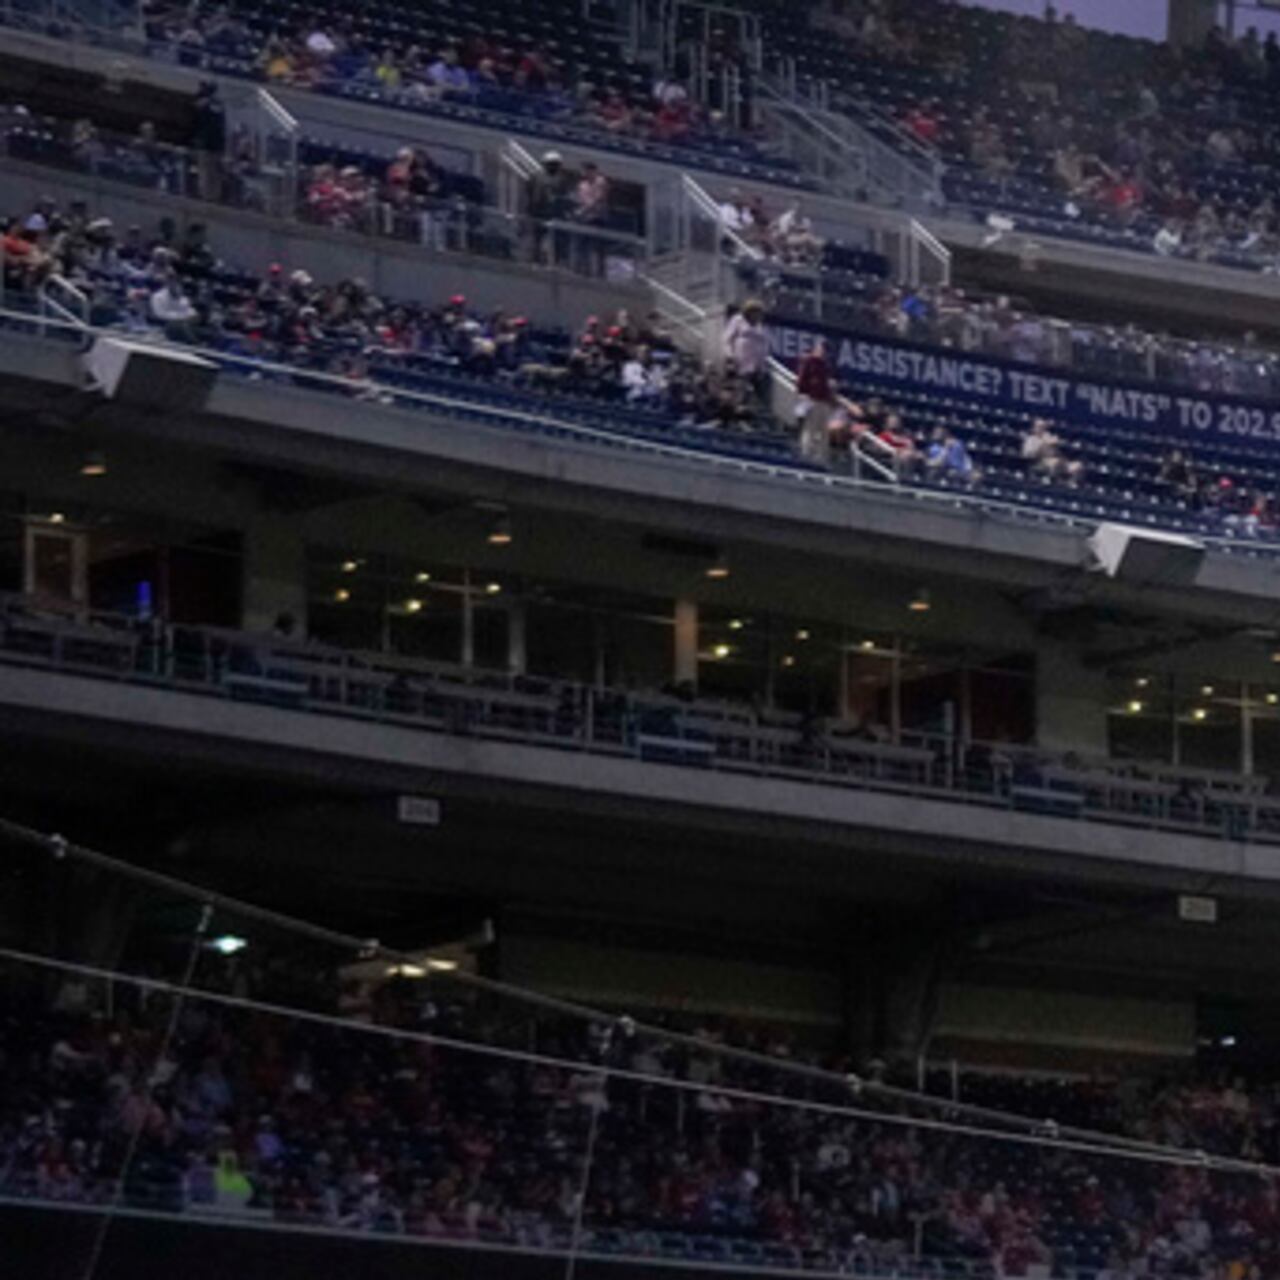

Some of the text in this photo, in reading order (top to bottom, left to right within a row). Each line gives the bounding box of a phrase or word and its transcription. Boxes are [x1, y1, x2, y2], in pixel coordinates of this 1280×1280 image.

[837, 338, 1002, 396] ASSISTANCE?
[1008, 370, 1070, 409] TEXT
[1176, 398, 1213, 430] TO
